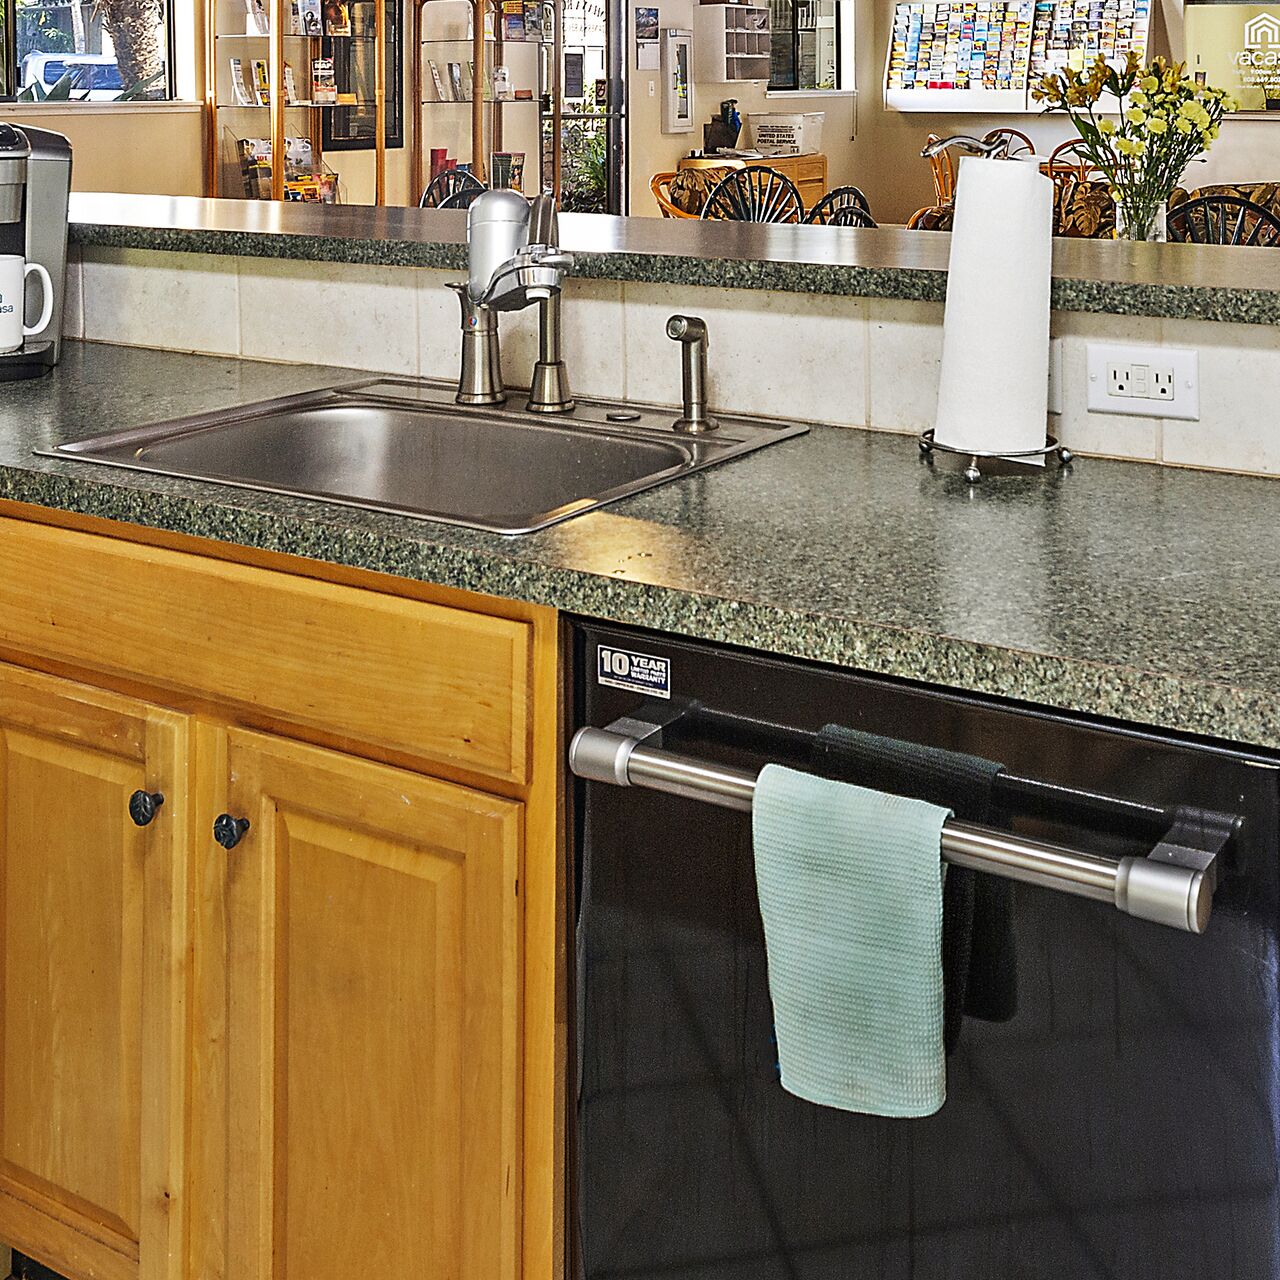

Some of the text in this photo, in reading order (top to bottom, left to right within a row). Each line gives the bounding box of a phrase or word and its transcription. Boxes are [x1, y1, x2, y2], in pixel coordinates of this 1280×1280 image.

[602, 650, 629, 676] 10
[631, 656, 666, 672] YEAR
[631, 672, 666, 684] WARRANTY
